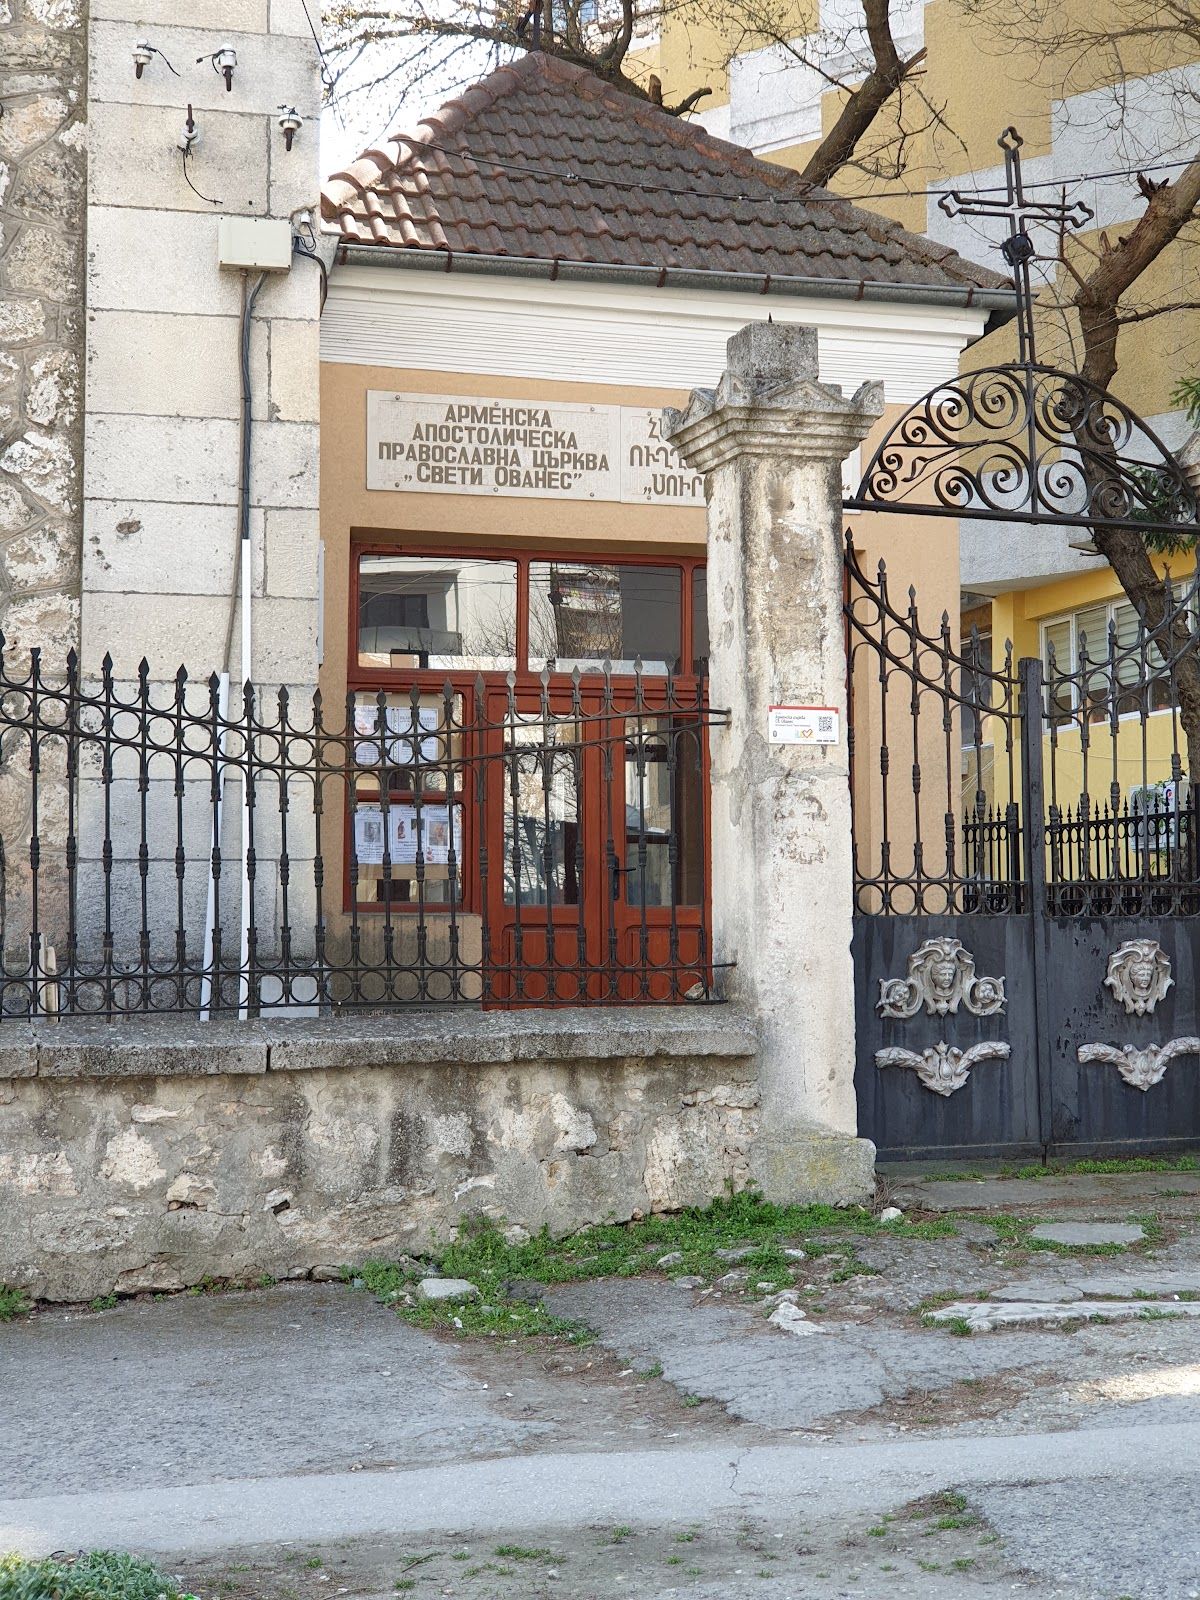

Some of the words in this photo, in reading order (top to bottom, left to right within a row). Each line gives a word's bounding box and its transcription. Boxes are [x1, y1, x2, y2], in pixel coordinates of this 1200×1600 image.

[444, 404, 552, 428] АРМЕНСКА
[412, 423, 578, 450] АПОСТОЛИЧЕСКА
[378, 441, 521, 468] ПРАВОСЛАВНА
[532, 449, 610, 472] ЦЪРКВА
[643, 473, 703, 497] „ՍՈՒՐ
